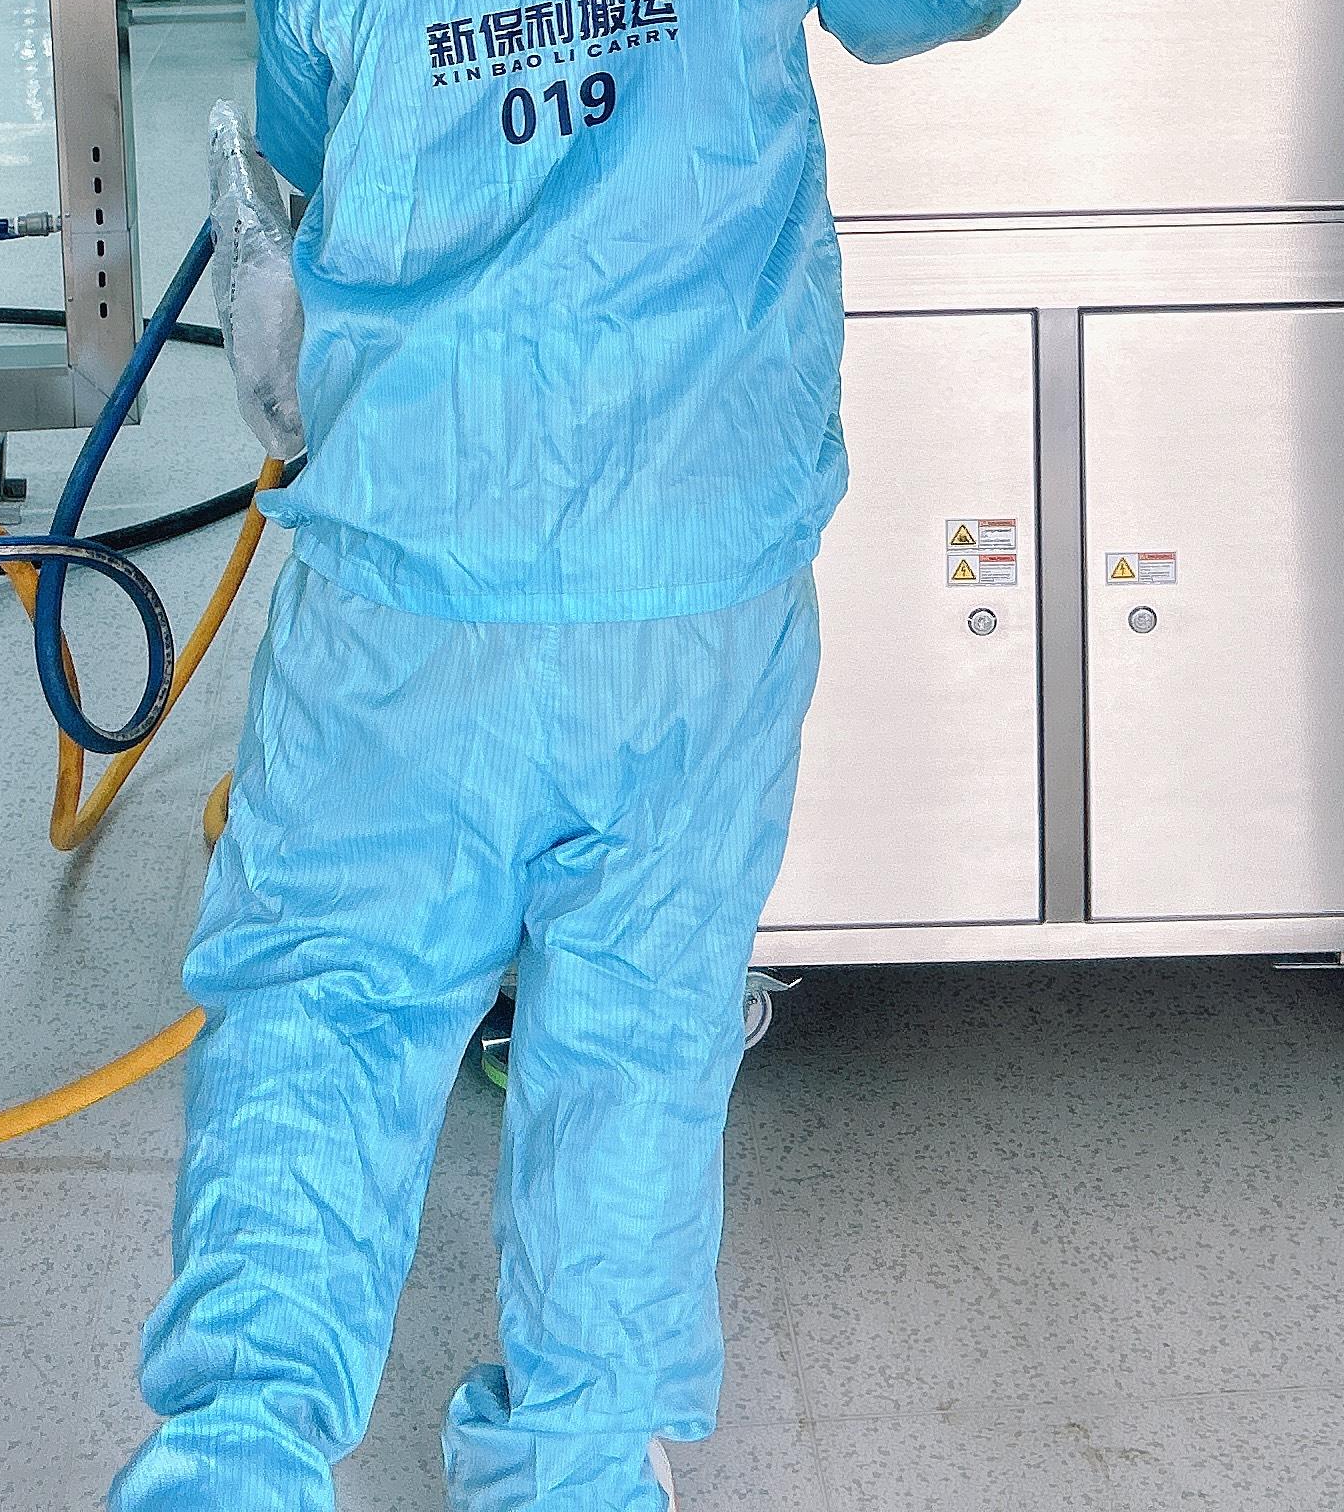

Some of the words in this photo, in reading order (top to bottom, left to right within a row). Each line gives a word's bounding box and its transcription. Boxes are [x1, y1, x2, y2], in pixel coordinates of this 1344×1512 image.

[433, 66, 481, 87] XIN
[492, 54, 542, 77] BAO
[554, 48, 575, 64] LI
[588, 28, 679, 58] CARRY
[501, 71, 617, 146] 019
